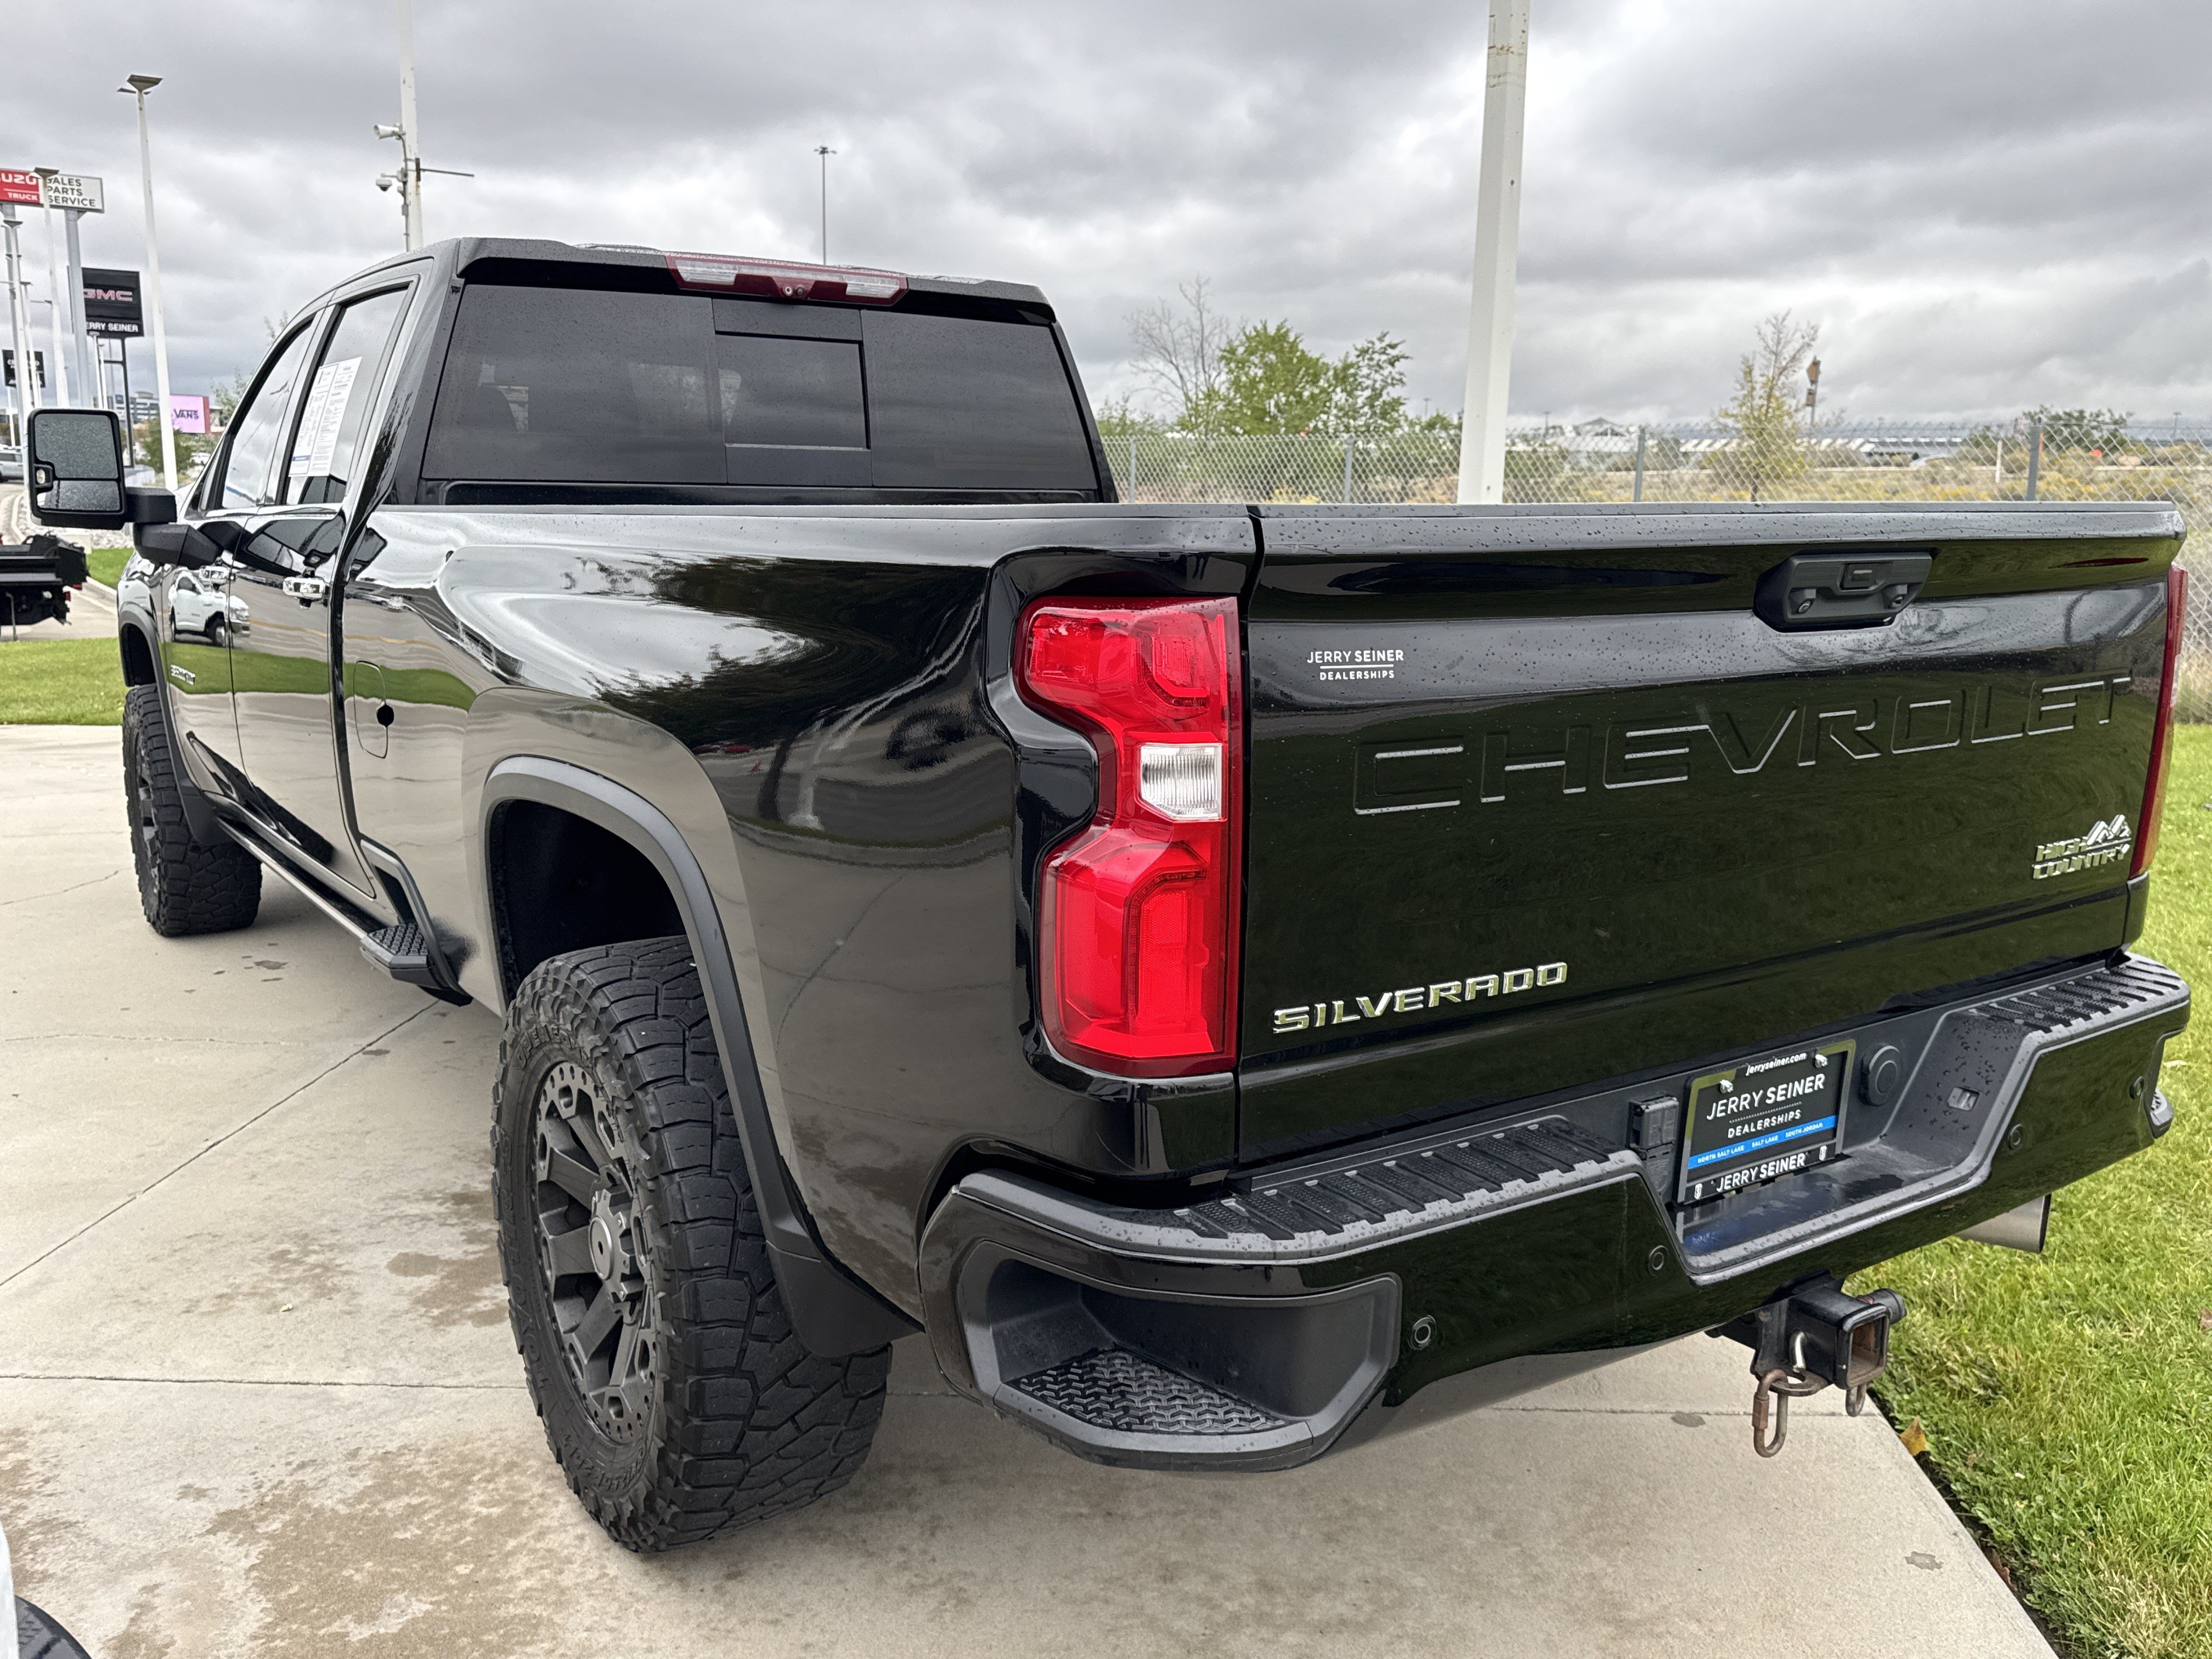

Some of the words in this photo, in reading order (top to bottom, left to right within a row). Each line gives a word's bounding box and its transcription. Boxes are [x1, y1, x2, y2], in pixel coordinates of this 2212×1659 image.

[7, 192, 38, 200] TRUCK
[48, 195, 95, 207] SERVICE
[83, 288, 133, 301] GMC
[87, 321, 106, 330] ERRY
[108, 323, 139, 332] SEINER
[173, 409, 199, 420] VANS
[1307, 651, 1351, 663] JERRY
[1355, 650, 1404, 662] SEINER
[1319, 670, 1395, 680] DEALERSHIPS
[1353, 667, 2132, 815] CHEVROLET
[2035, 836, 2089, 862] HIGH
[2032, 843, 2130, 879] COUNTRY
[1272, 961, 1568, 1034] SILVERADO
[1745, 1052, 1808, 1076] jerryseiner.com
[1707, 1089, 1764, 1120] JERRY
[1765, 1073, 1826, 1105] SEINER
[1728, 1109, 1802, 1138] DEALERSHIPS
[1785, 1128, 1802, 1138] SOUTH
[1802, 1122, 1823, 1133] JORDAN
[1752, 1139, 1764, 1148] SALT
[1765, 1135, 1779, 1144] LAKE
[1697, 1154, 1716, 1164] NORTH
[1717, 1150, 1730, 1158] SALT
[1731, 1145, 1745, 1154] LAKE
[1717, 1166, 1758, 1192] JERRY
[1759, 1152, 1805, 1178] SEINER
